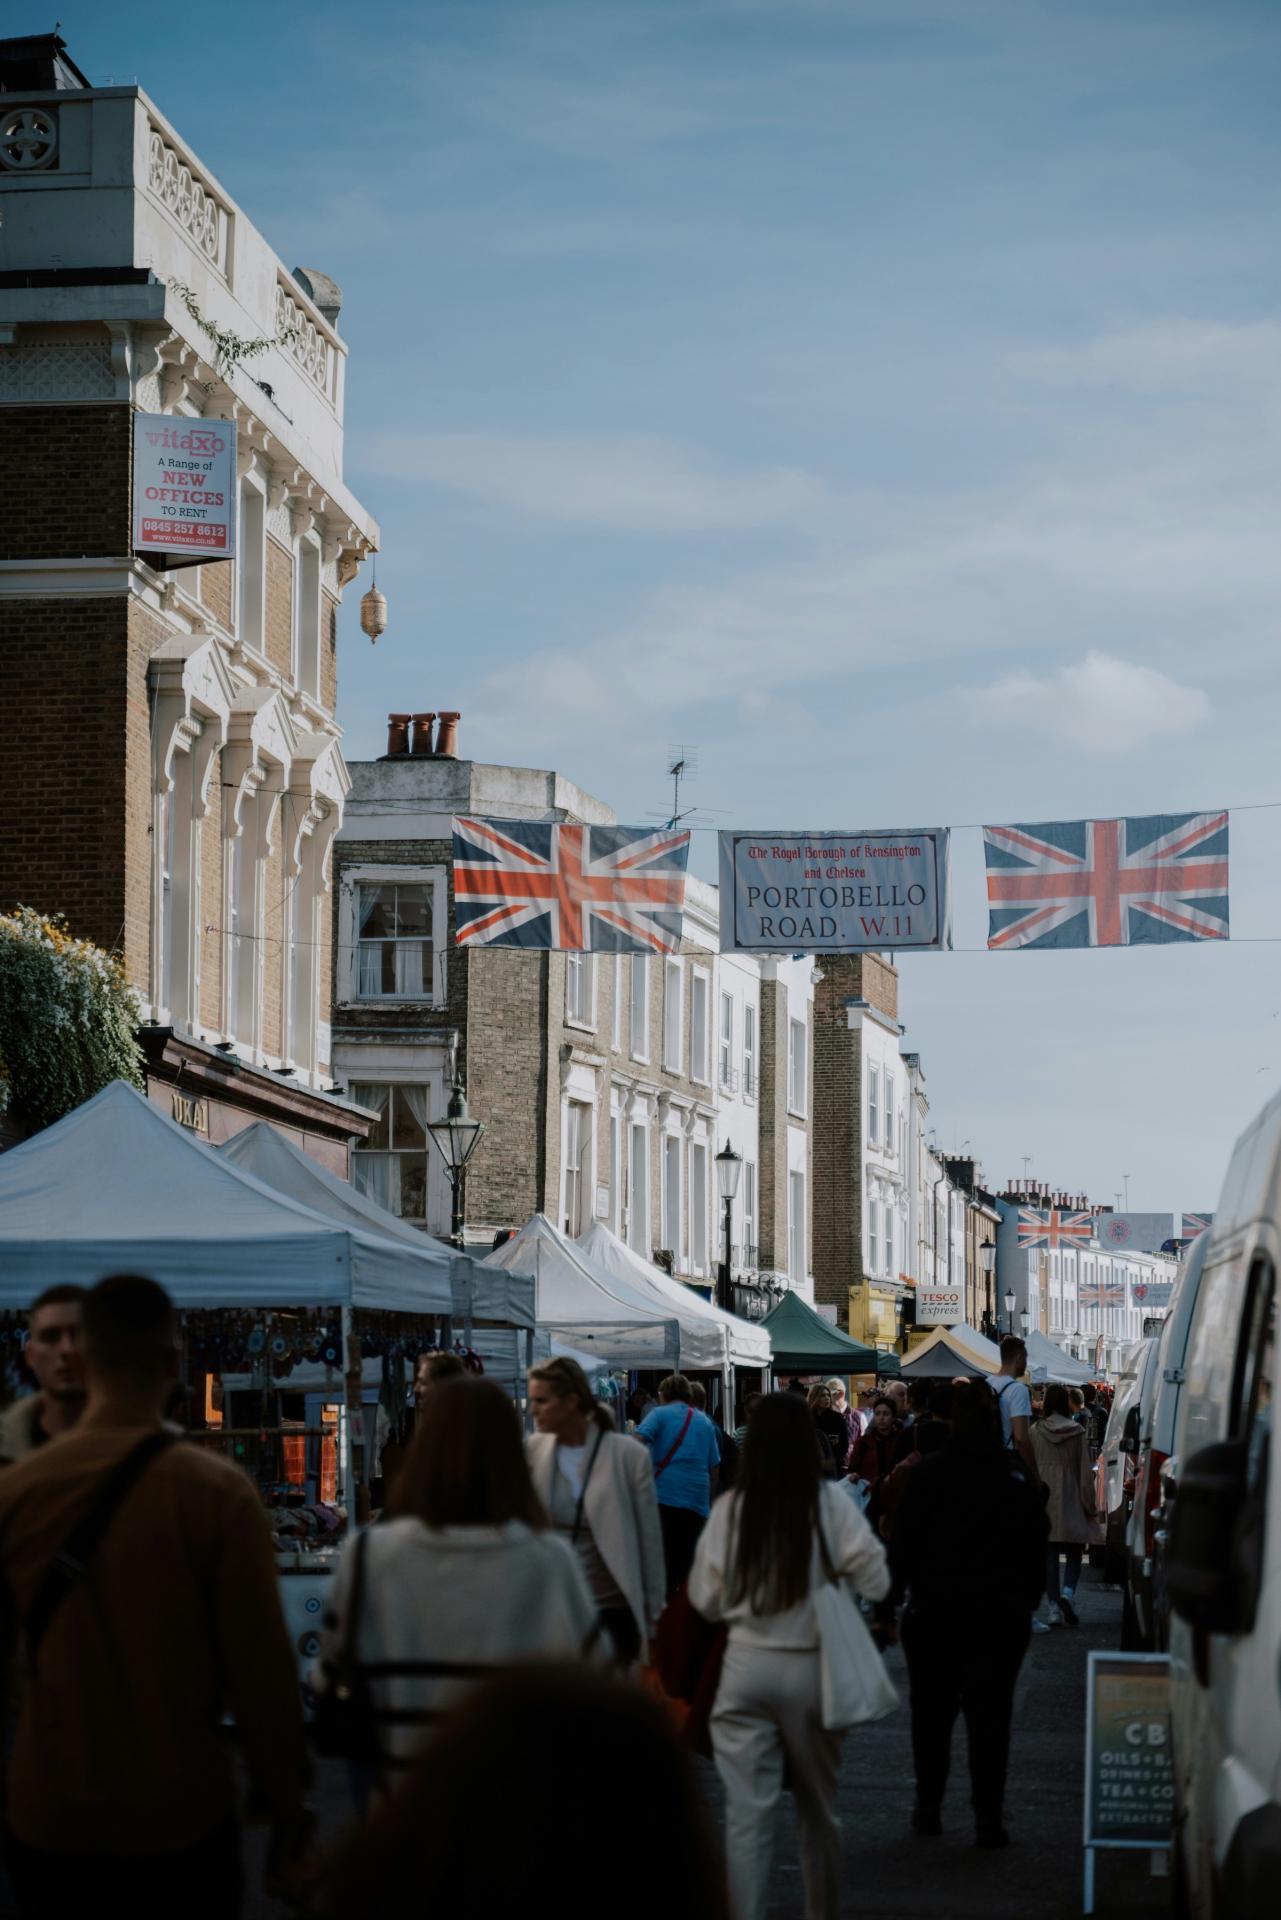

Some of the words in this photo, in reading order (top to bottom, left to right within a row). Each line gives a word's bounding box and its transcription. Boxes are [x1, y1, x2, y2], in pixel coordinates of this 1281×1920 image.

[145, 428, 225, 455] vitaxo
[158, 458, 165, 466] A
[168, 459, 200, 470] Range
[203, 461, 212, 470] of
[163, 471, 207, 487] NEW
[145, 487, 224, 506] OFFICES
[162, 506, 176, 515] TO
[179, 508, 208, 518] RENT
[144, 521, 172, 531] 0845
[174, 523, 194, 534] 257
[197, 526, 224, 537] 8612
[748, 846, 768, 859] The
[771, 846, 801, 863] Royal
[805, 846, 846, 862] Borough
[850, 846, 861, 858] of
[864, 844, 921, 860] Kensington
[804, 868, 822, 879] and
[826, 866, 866, 879] Chelsea
[747, 884, 926, 909] PORTOBELLO
[860, 915, 913, 937] W.11
[921, 1293, 959, 1302] TESCO
[921, 1306, 960, 1318] express
[1125, 1723, 1166, 1745] CB
[1100, 1752, 1140, 1766] OILS
[1100, 1783, 1134, 1797] TEA
[1150, 1785, 1174, 1798] CO
